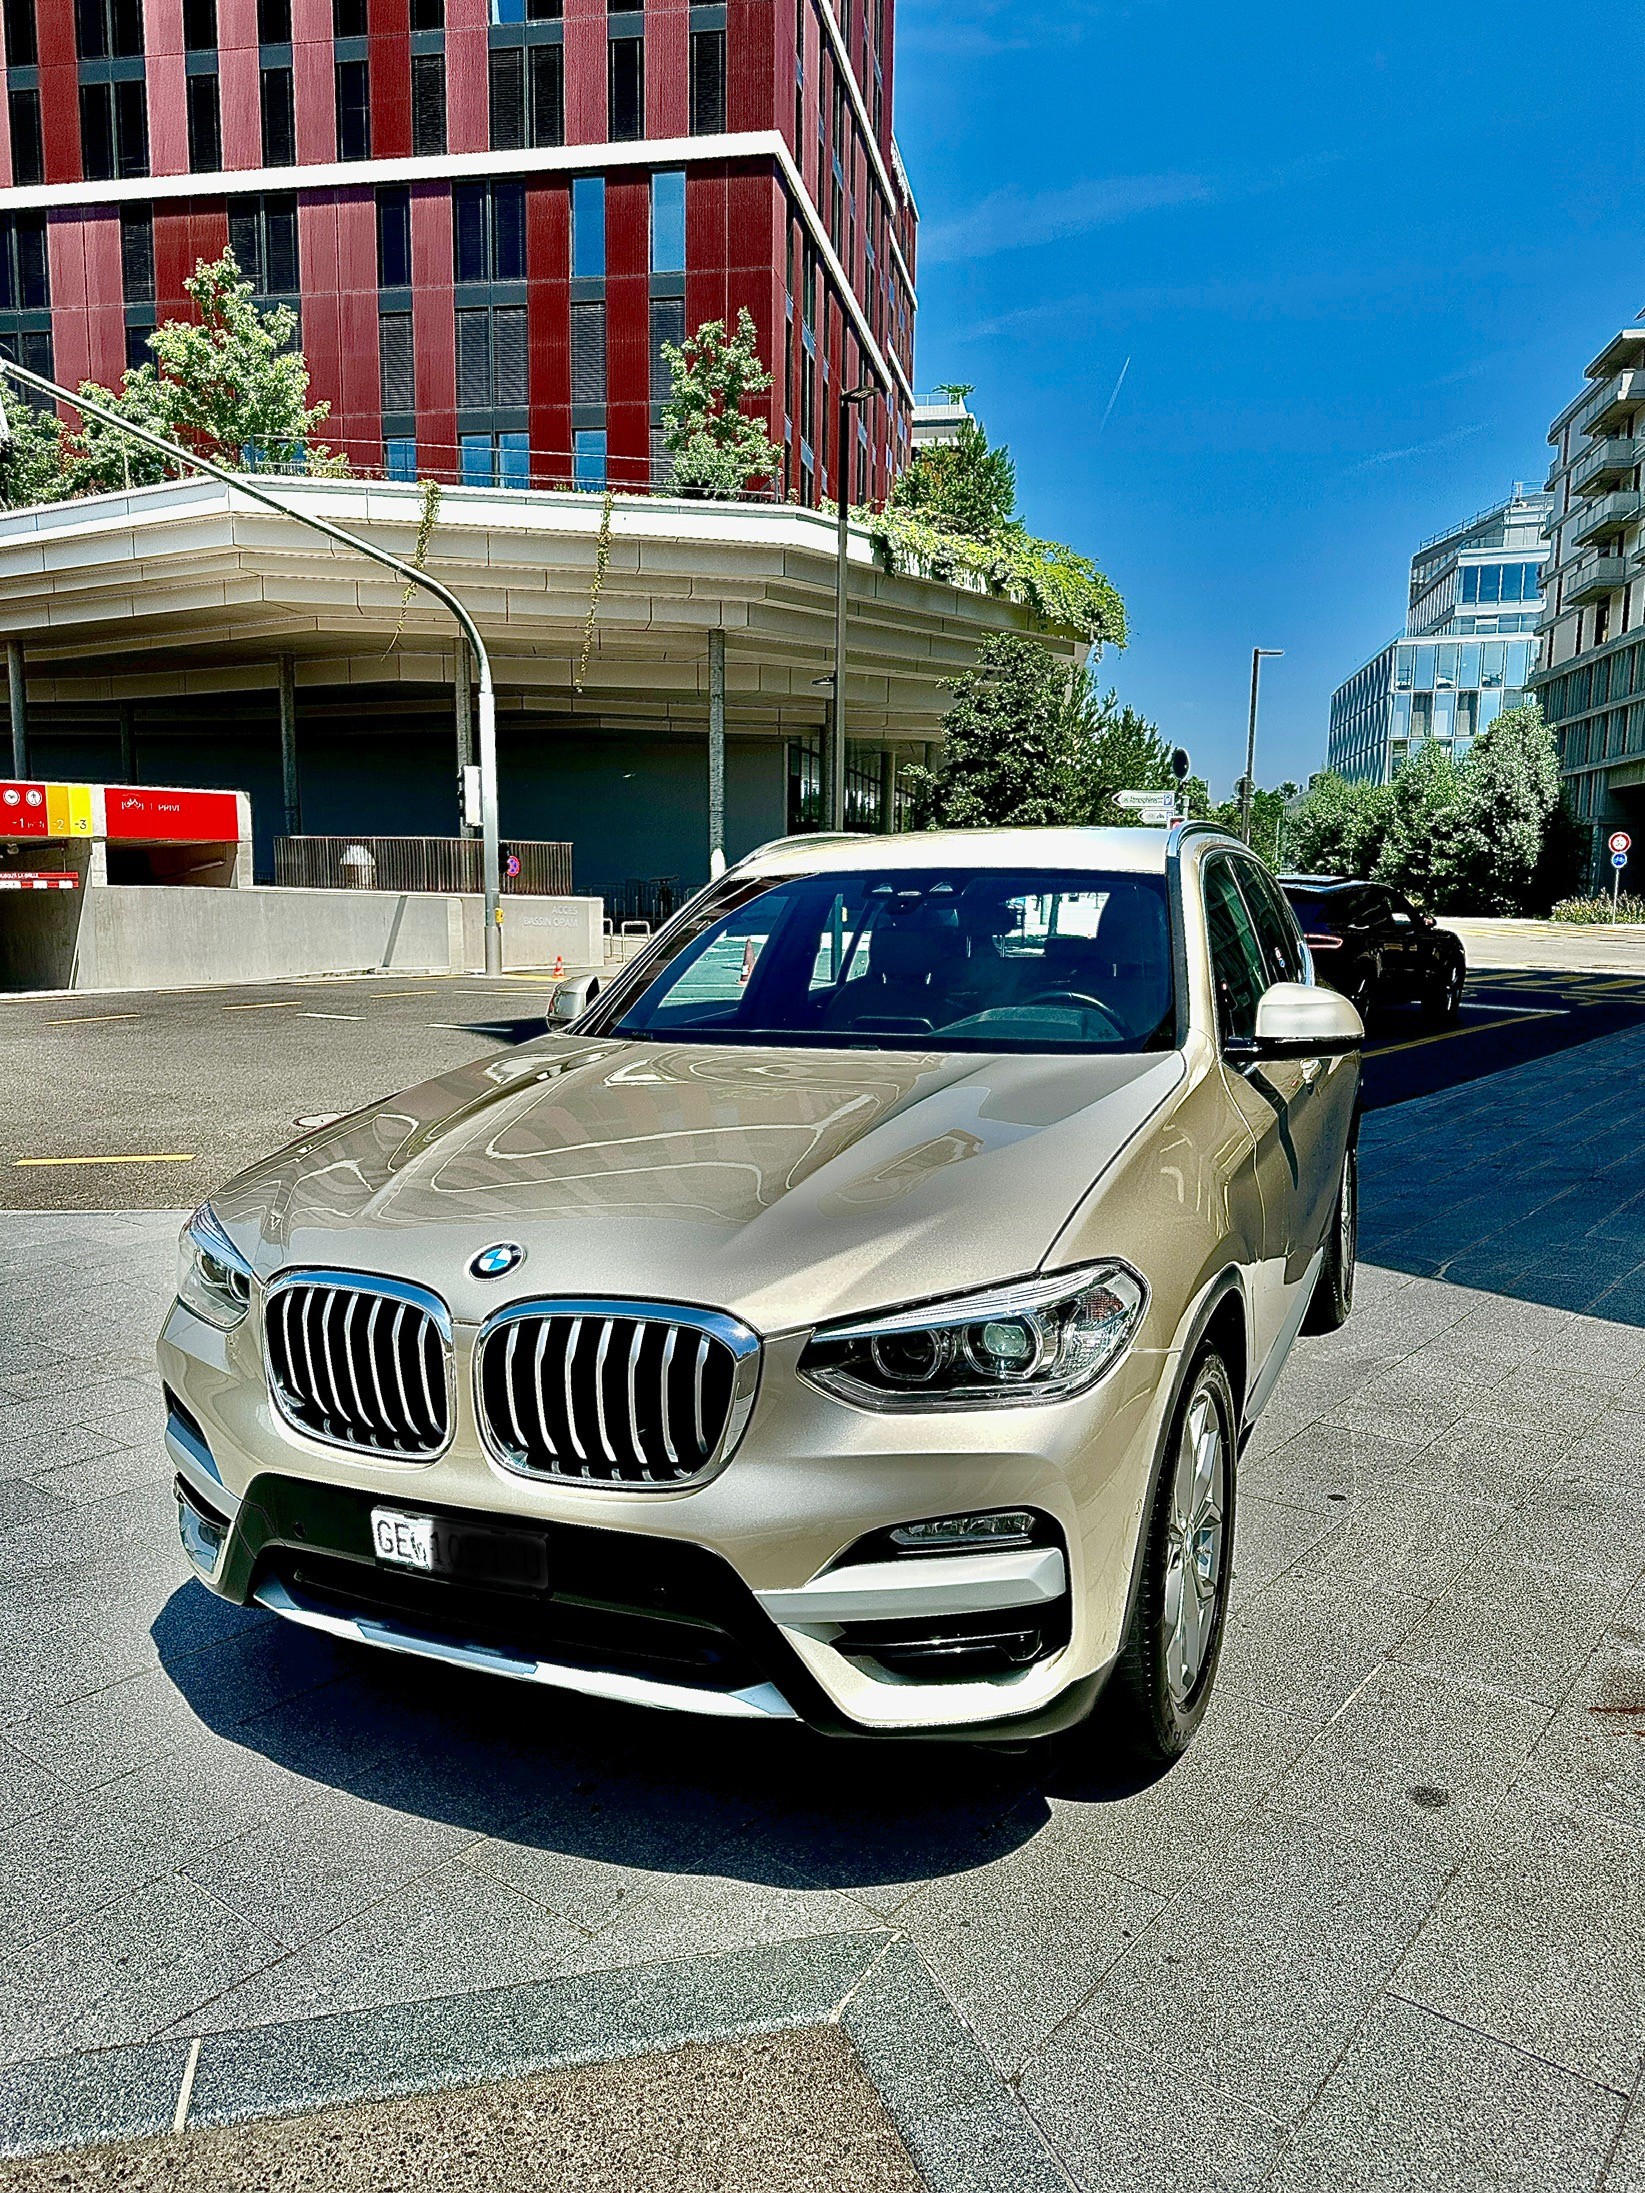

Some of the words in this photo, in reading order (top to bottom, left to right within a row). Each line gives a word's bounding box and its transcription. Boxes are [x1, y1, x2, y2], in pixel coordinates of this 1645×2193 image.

[52, 819, 64, 830] -2
[75, 819, 87, 830] -3
[524, 916, 551, 926] BASSIN
[377, 1519, 413, 1559] GE
